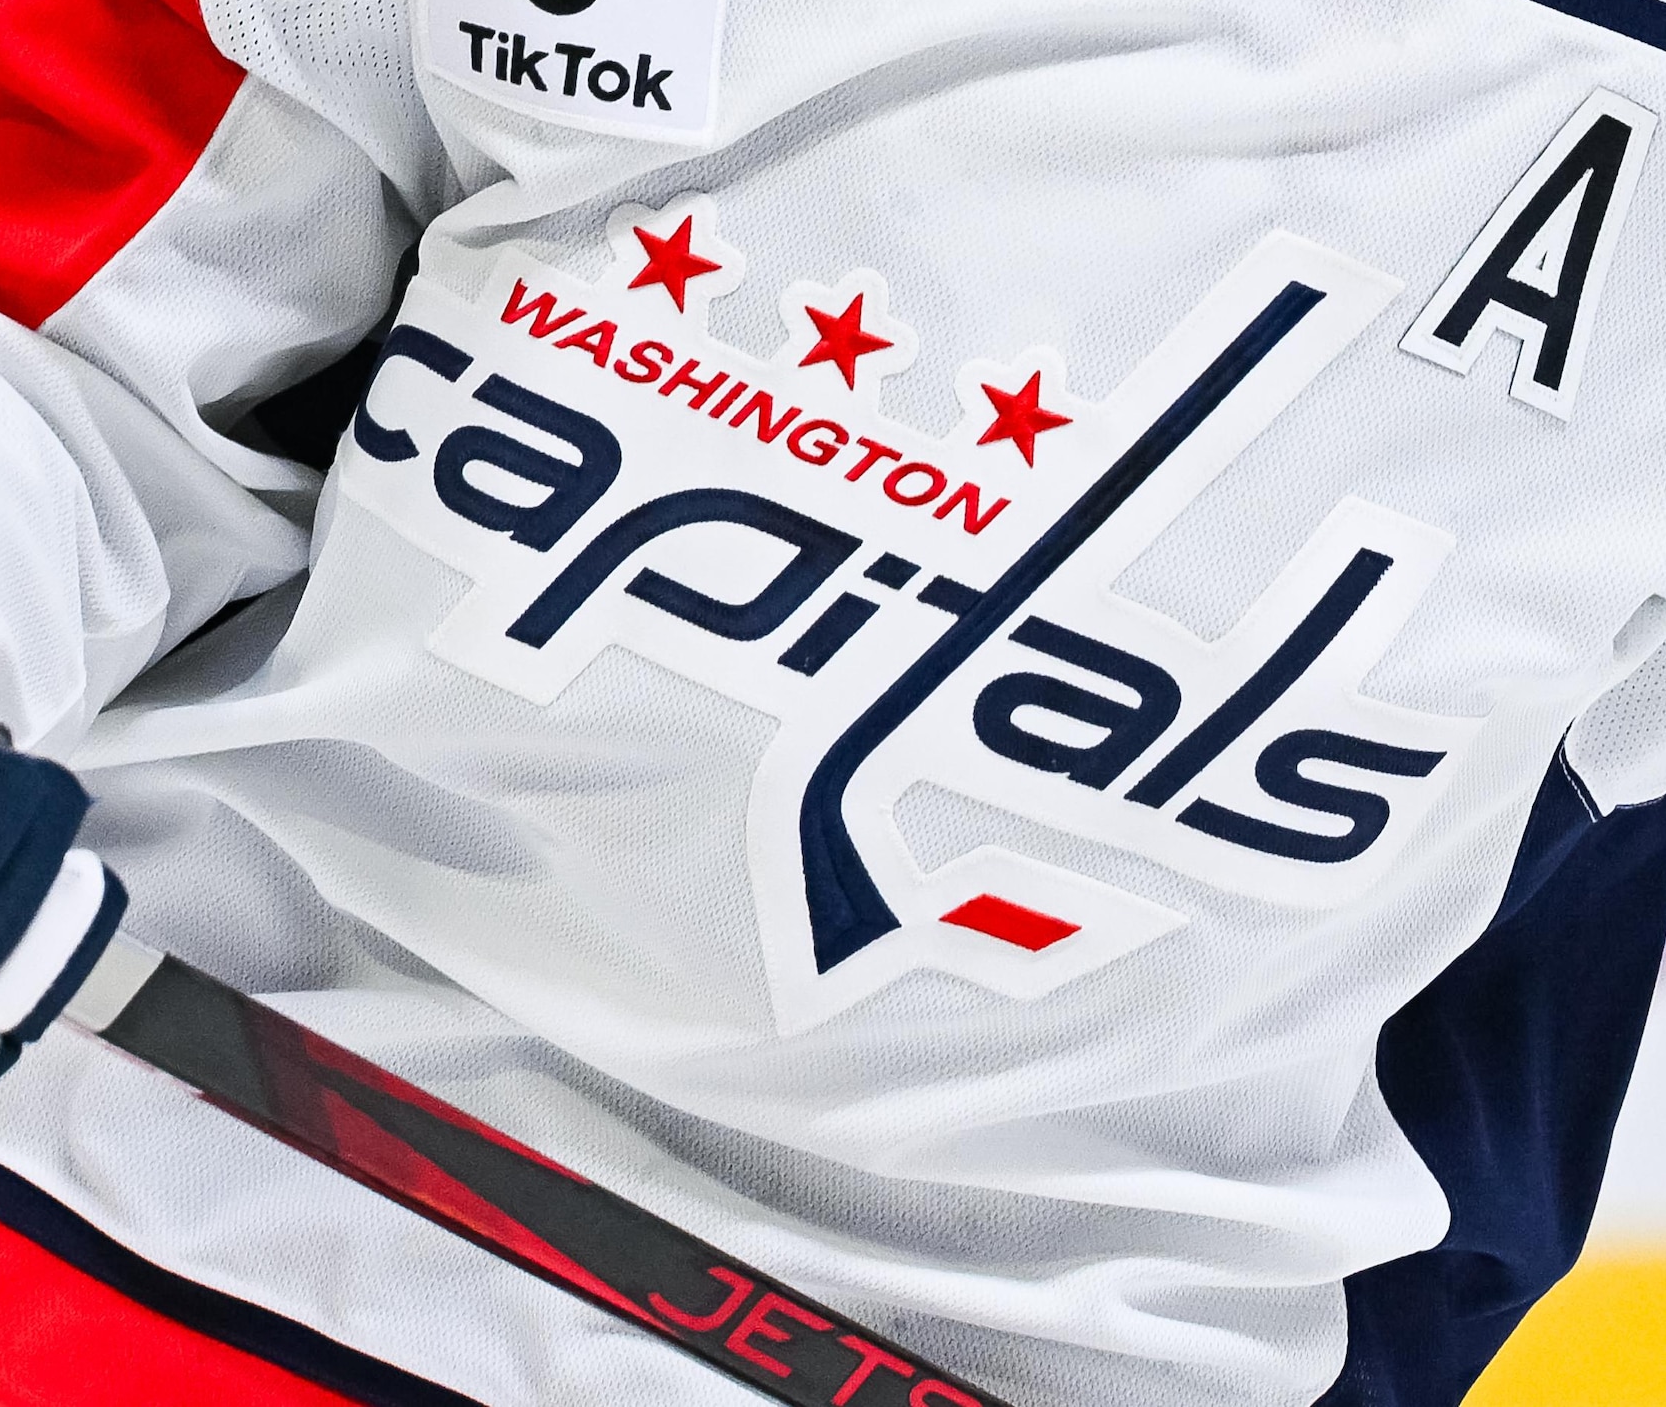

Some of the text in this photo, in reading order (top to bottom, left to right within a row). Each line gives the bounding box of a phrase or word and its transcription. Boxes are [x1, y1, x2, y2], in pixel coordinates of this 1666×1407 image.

[459, 20, 674, 112] TikTok
[1432, 113, 1633, 391] A
[500, 277, 1013, 536] WASHINGTON
[354, 281, 1448, 975] capitals
